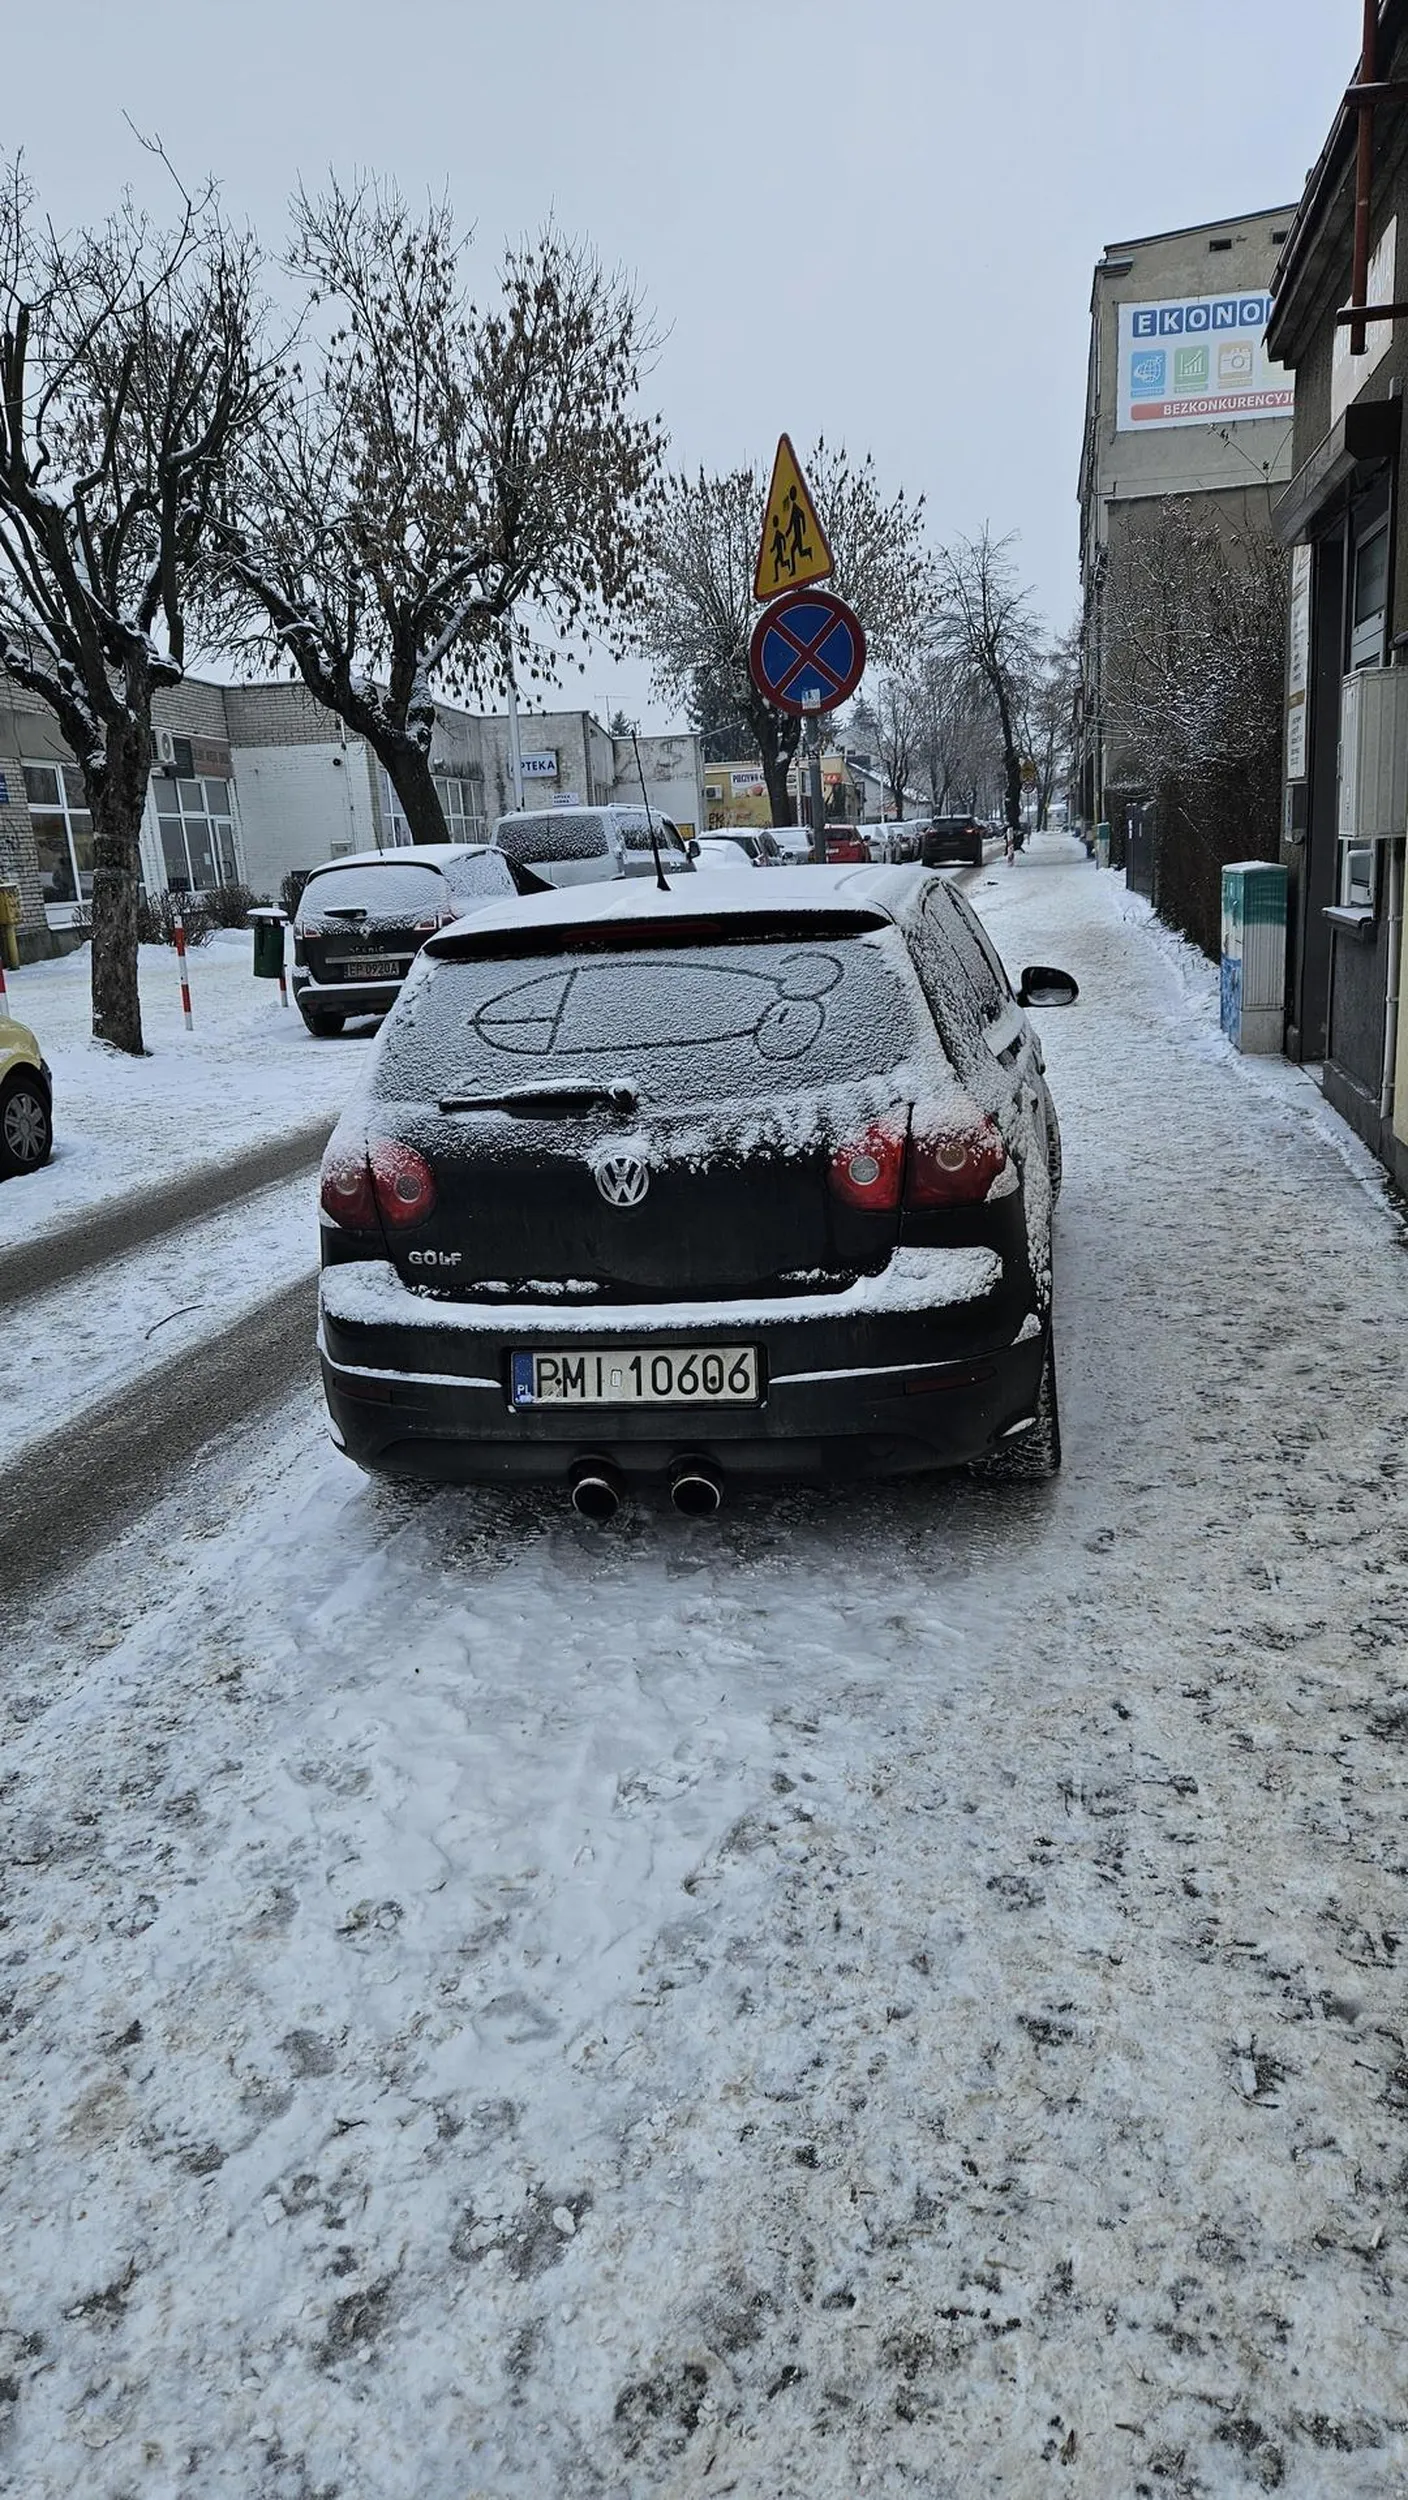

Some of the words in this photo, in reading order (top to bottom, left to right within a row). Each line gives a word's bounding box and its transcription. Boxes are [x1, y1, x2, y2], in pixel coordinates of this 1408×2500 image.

[1137, 299, 1274, 334] EKONO
[511, 760, 555, 773] PTEKA
[408, 1250, 462, 1266] GOLF
[536, 1357, 602, 1398] PMI
[629, 1353, 750, 1396] 10606
[517, 1385, 531, 1395] PL
